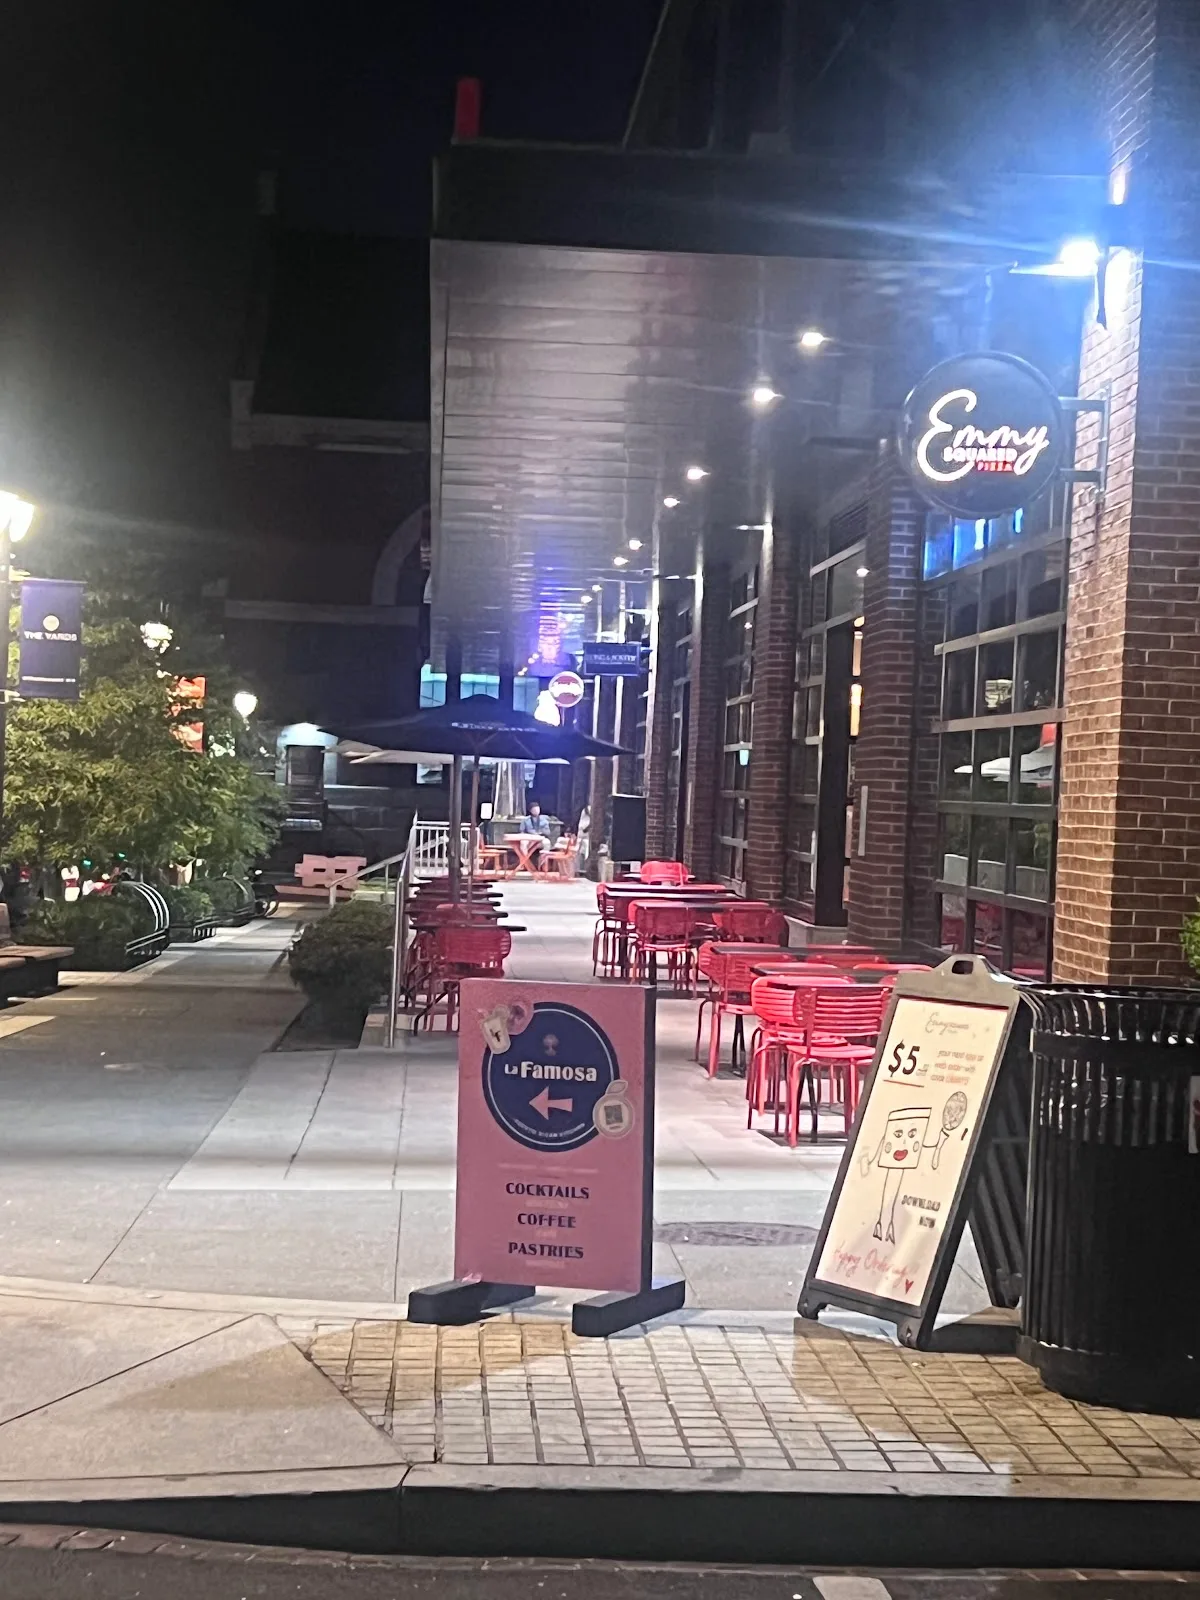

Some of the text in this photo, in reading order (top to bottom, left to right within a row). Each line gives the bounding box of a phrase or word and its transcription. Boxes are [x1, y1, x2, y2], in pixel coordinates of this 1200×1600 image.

[916, 388, 1050, 482] Emmy
[888, 1039, 921, 1077] $5
[504, 1061, 598, 1082] La Famosa
[505, 1182, 590, 1200] COCKTAILS
[901, 1194, 941, 1212] DOWNLOAD
[517, 1213, 577, 1229] COFFEE
[508, 1241, 584, 1259] PASTRIES
